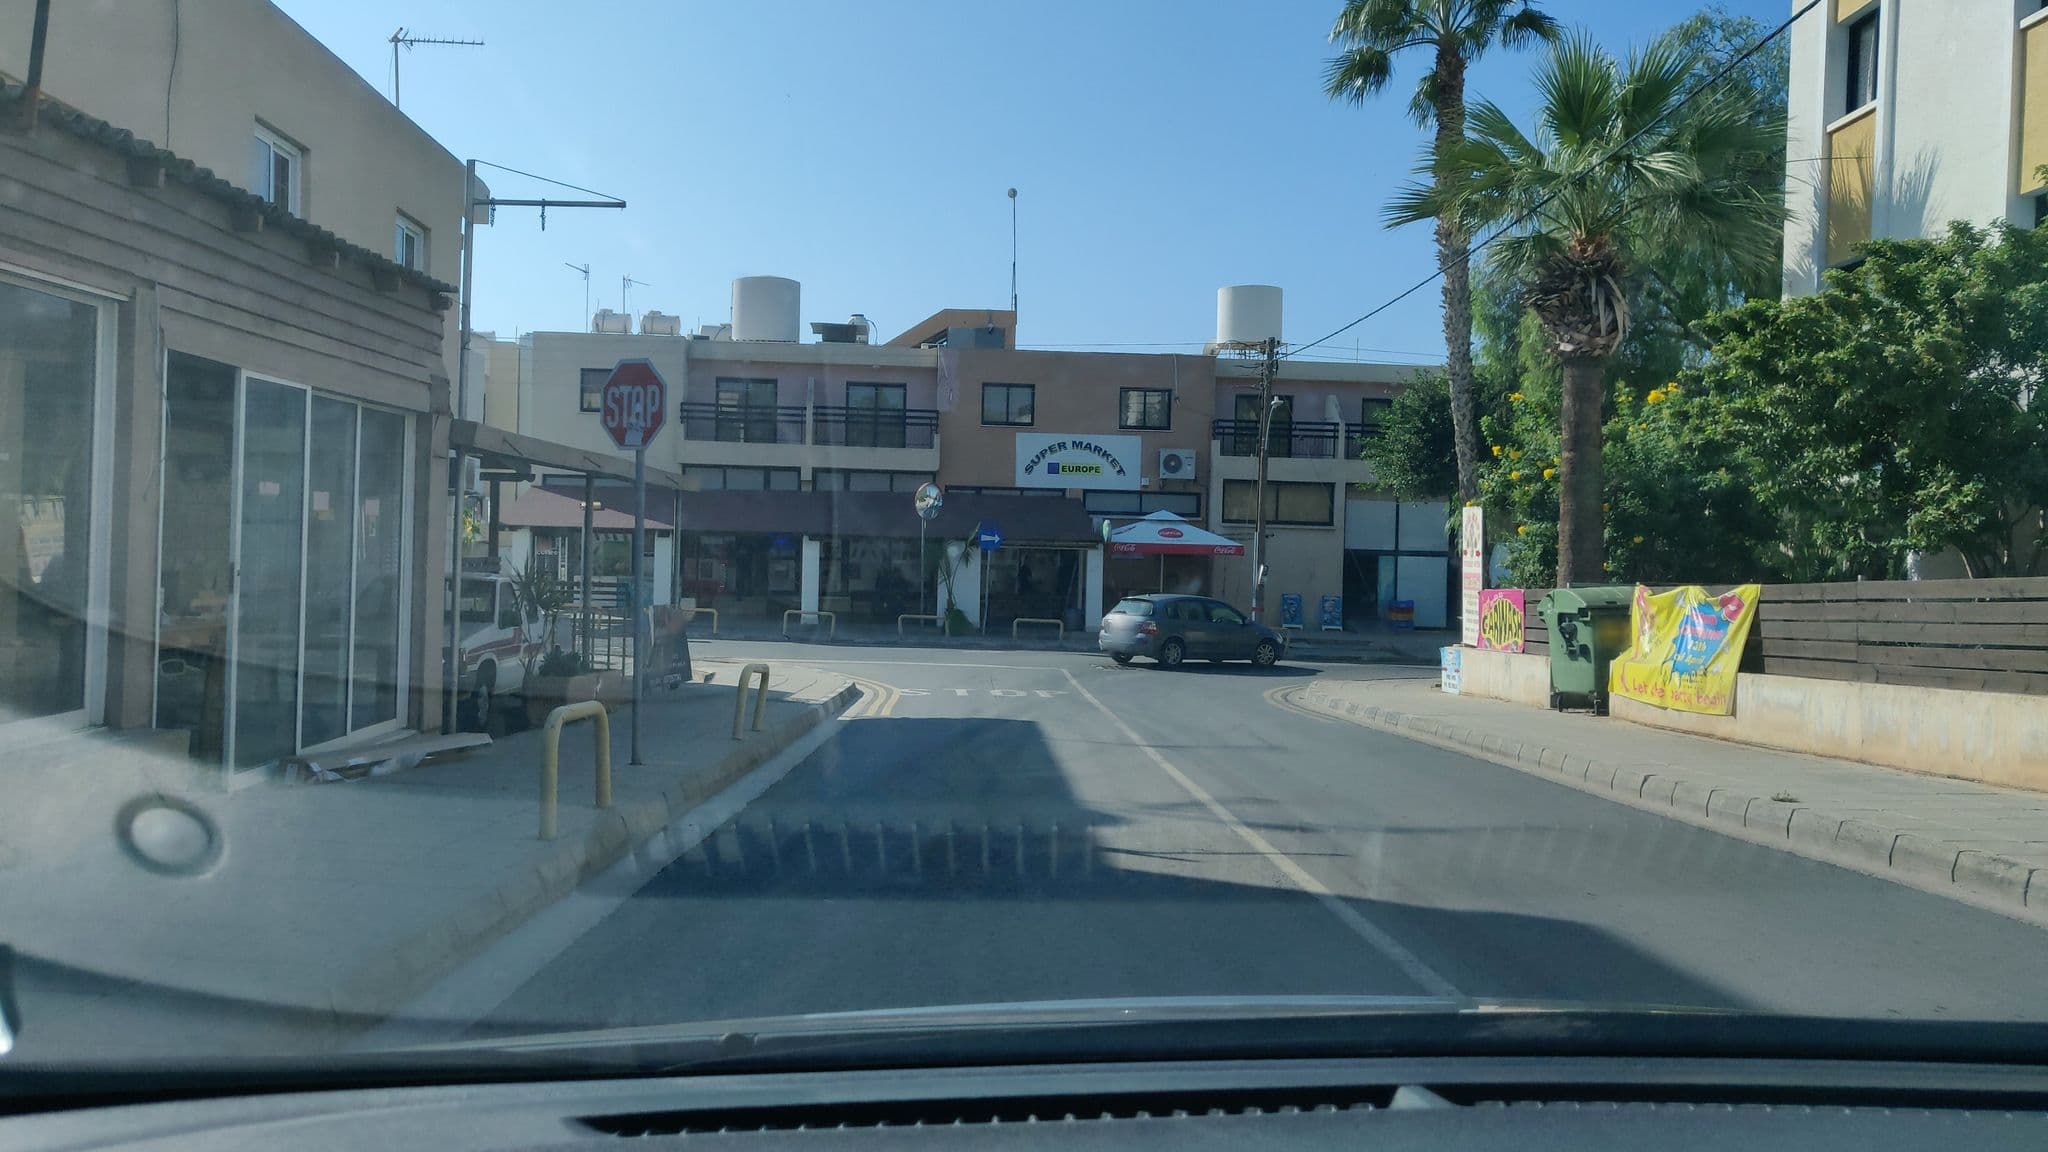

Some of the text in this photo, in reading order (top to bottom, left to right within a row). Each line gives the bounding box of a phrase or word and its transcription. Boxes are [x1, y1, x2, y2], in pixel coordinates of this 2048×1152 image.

[607, 384, 660, 428] STOP
[1024, 440, 1126, 477] SUPER MARKET
[1061, 464, 1100, 474] EUROPE
